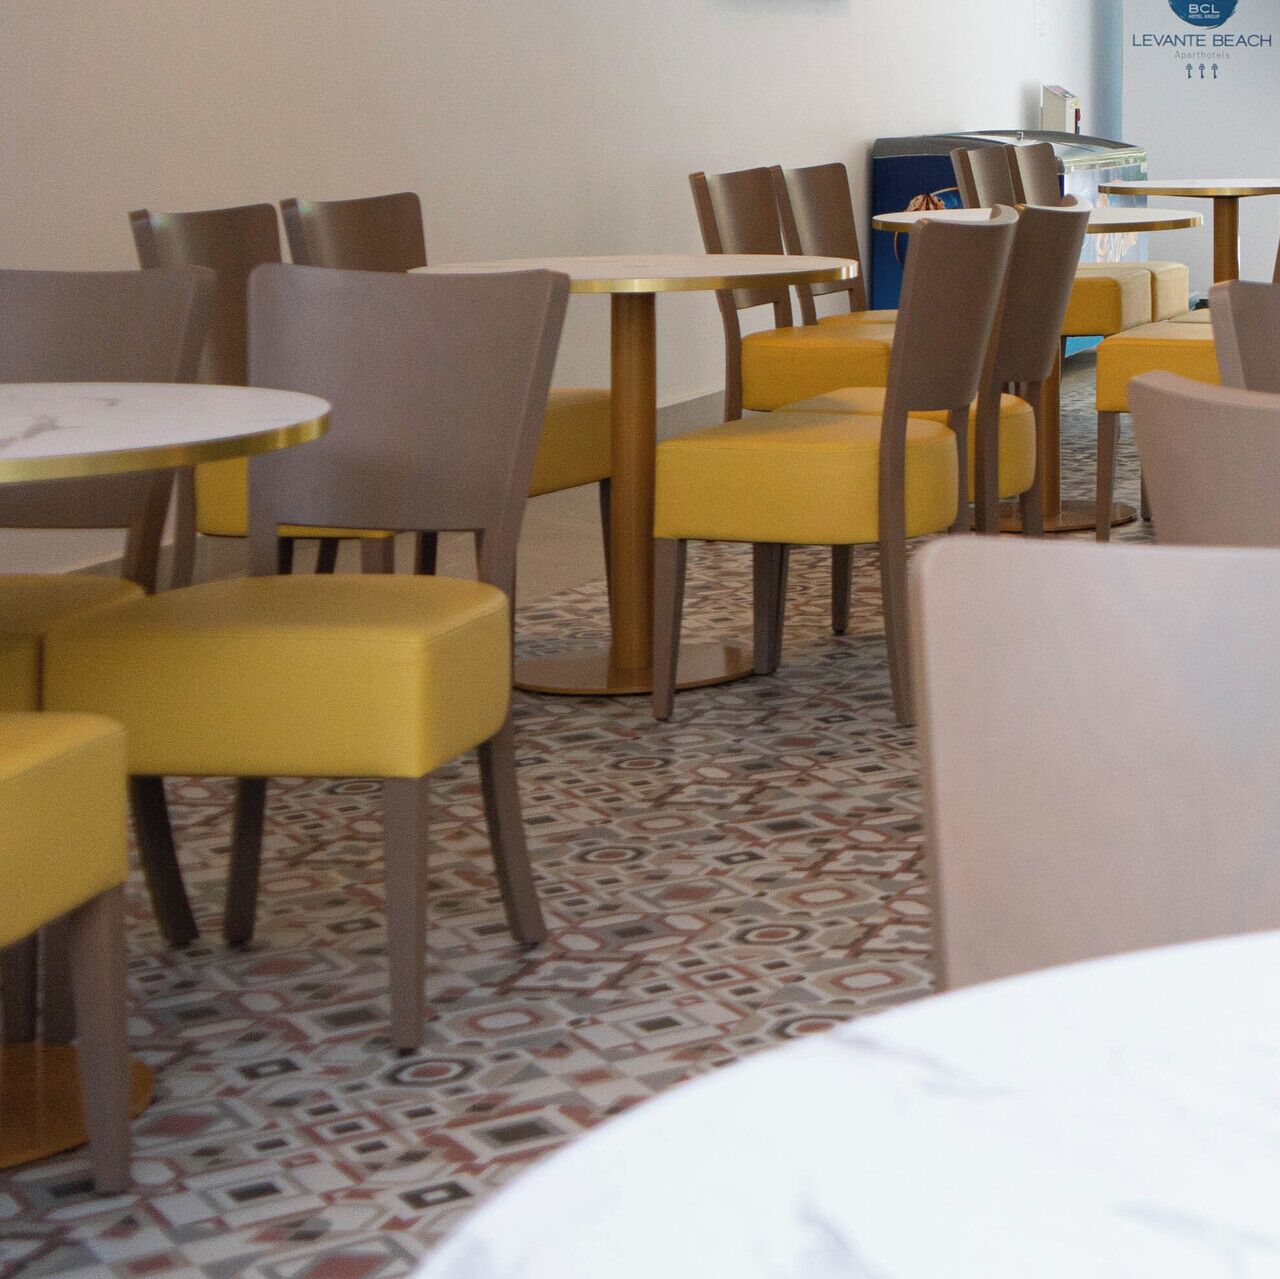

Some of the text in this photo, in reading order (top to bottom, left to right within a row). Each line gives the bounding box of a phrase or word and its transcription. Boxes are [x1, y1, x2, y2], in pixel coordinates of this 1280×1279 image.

[1188, 4, 1220, 14] BCL
[1132, 34, 1272, 47] LEVANTE BEACH
[1174, 50, 1231, 60] Aparthotels
